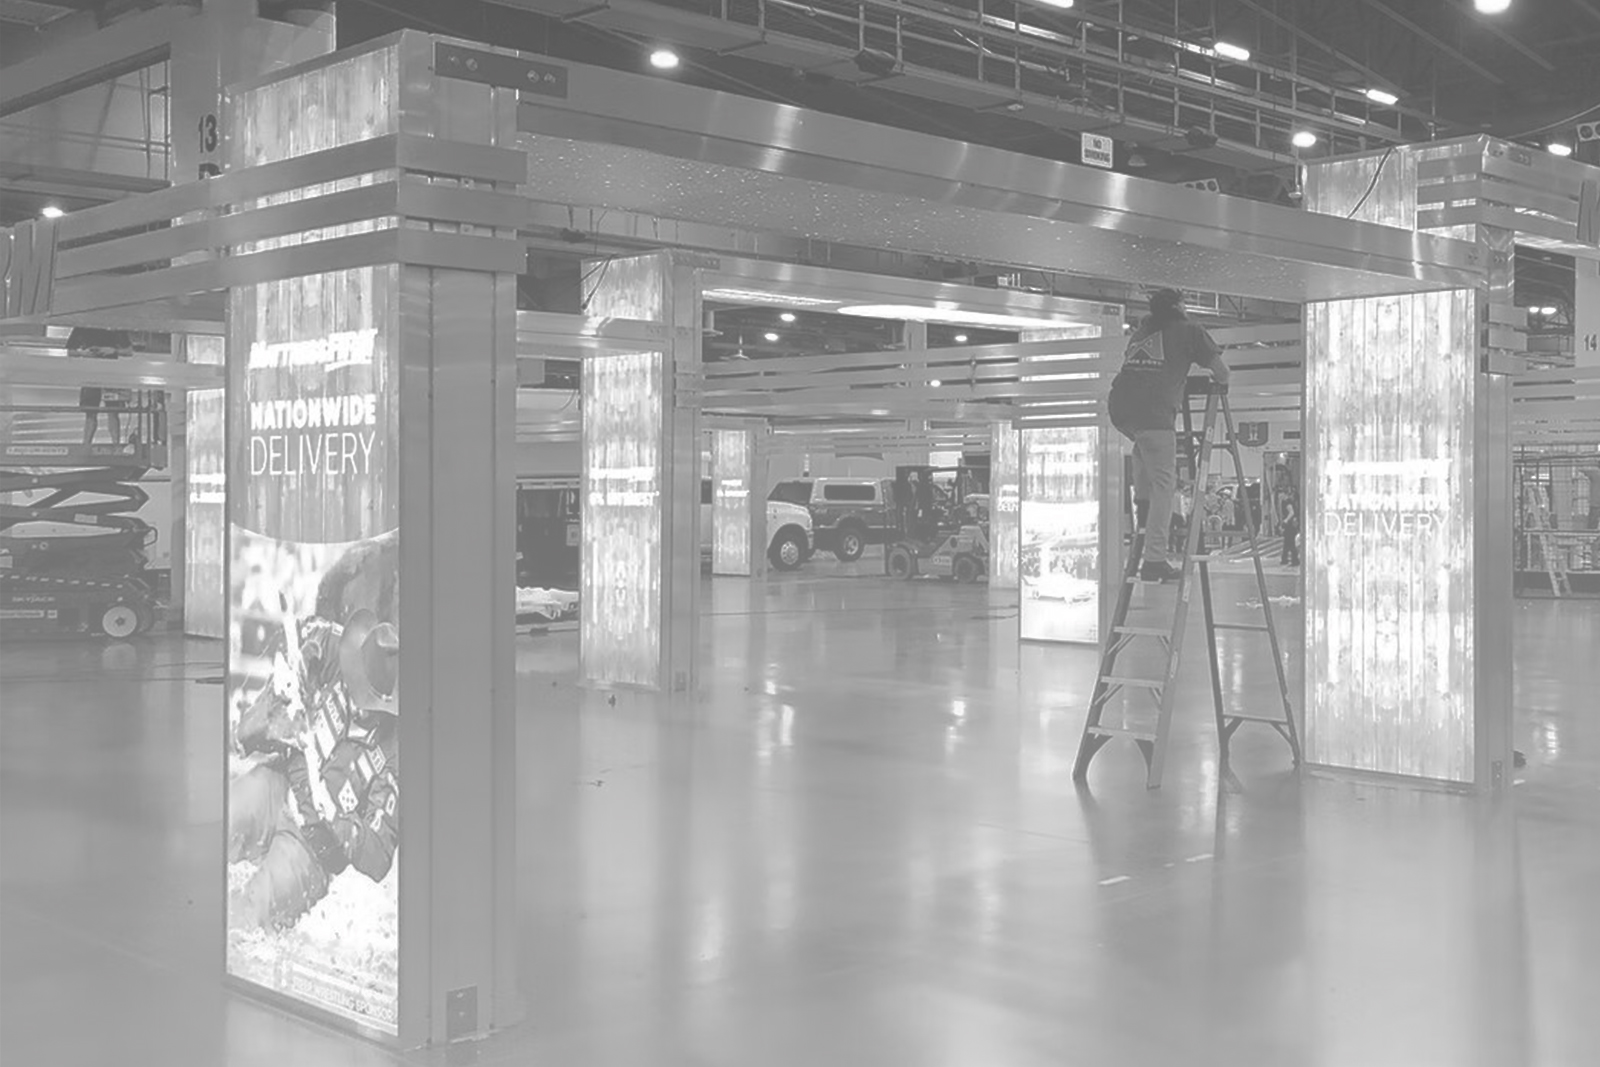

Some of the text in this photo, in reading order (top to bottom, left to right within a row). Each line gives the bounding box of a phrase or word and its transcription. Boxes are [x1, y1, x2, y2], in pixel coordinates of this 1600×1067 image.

[199, 114, 217, 153] 13
[1584, 334, 1597, 351] 14
[251, 394, 377, 430] NATIONWIDE
[250, 431, 377, 476] DELIVERY
[1324, 511, 1450, 536] DELIVERY
